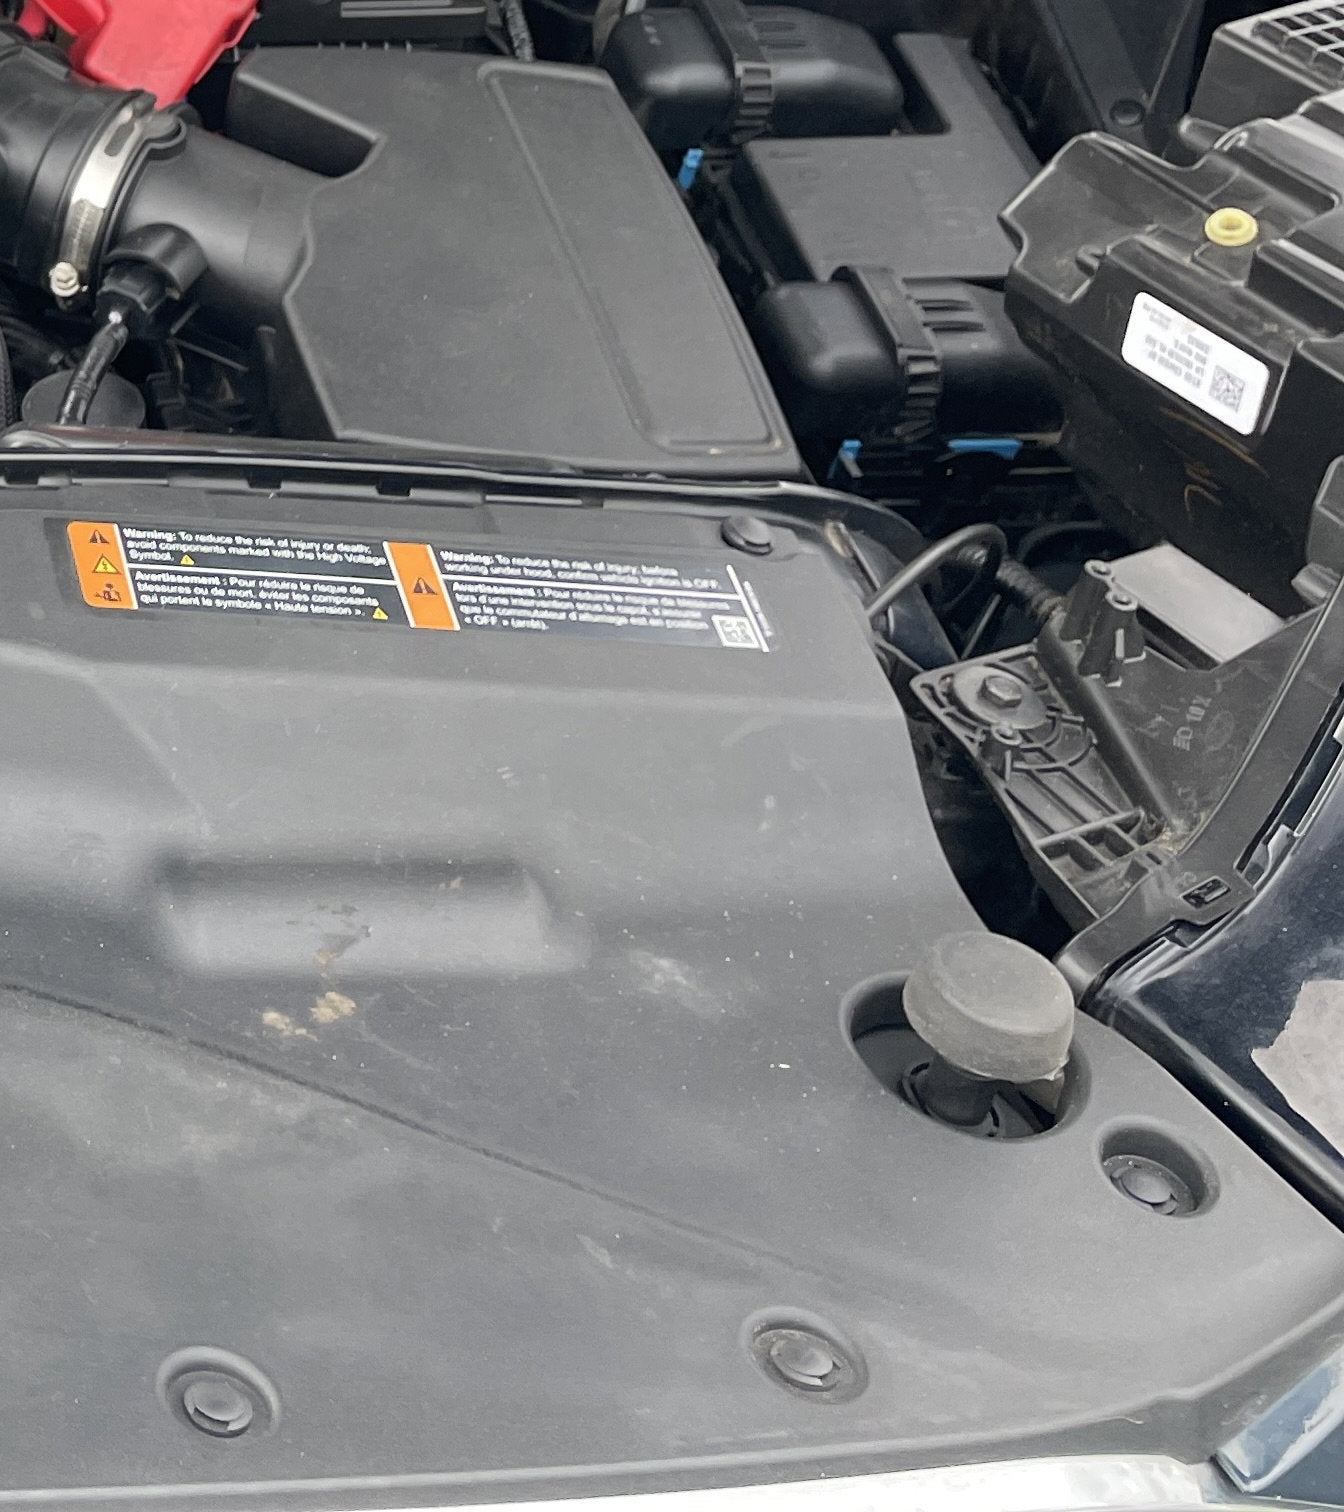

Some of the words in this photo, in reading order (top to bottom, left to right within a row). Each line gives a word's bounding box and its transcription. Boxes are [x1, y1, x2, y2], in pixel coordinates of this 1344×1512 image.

[123, 528, 176, 542] Warning:
[178, 531, 192, 541] To
[195, 534, 233, 544] reduce
[235, 535, 253, 545] the
[255, 537, 275, 546] risk
[127, 540, 157, 549] avoid
[159, 542, 226, 554] components
[228, 546, 270, 557] marked
[272, 549, 294, 559] with
[297, 550, 314, 560] the
[344, 553, 386, 566] Voltage
[135, 571, 220, 585] Avertissement
[229, 577, 256, 587] Pour
[350, 585, 364, 595] de
[137, 582, 191, 594] blessures
[193, 587, 208, 595] ou
[211, 587, 225, 596] de
[312, 594, 379, 606] composants
[140, 594, 158, 604] qui
[160, 595, 200, 606] portent
[214, 599, 262, 609] symbole
